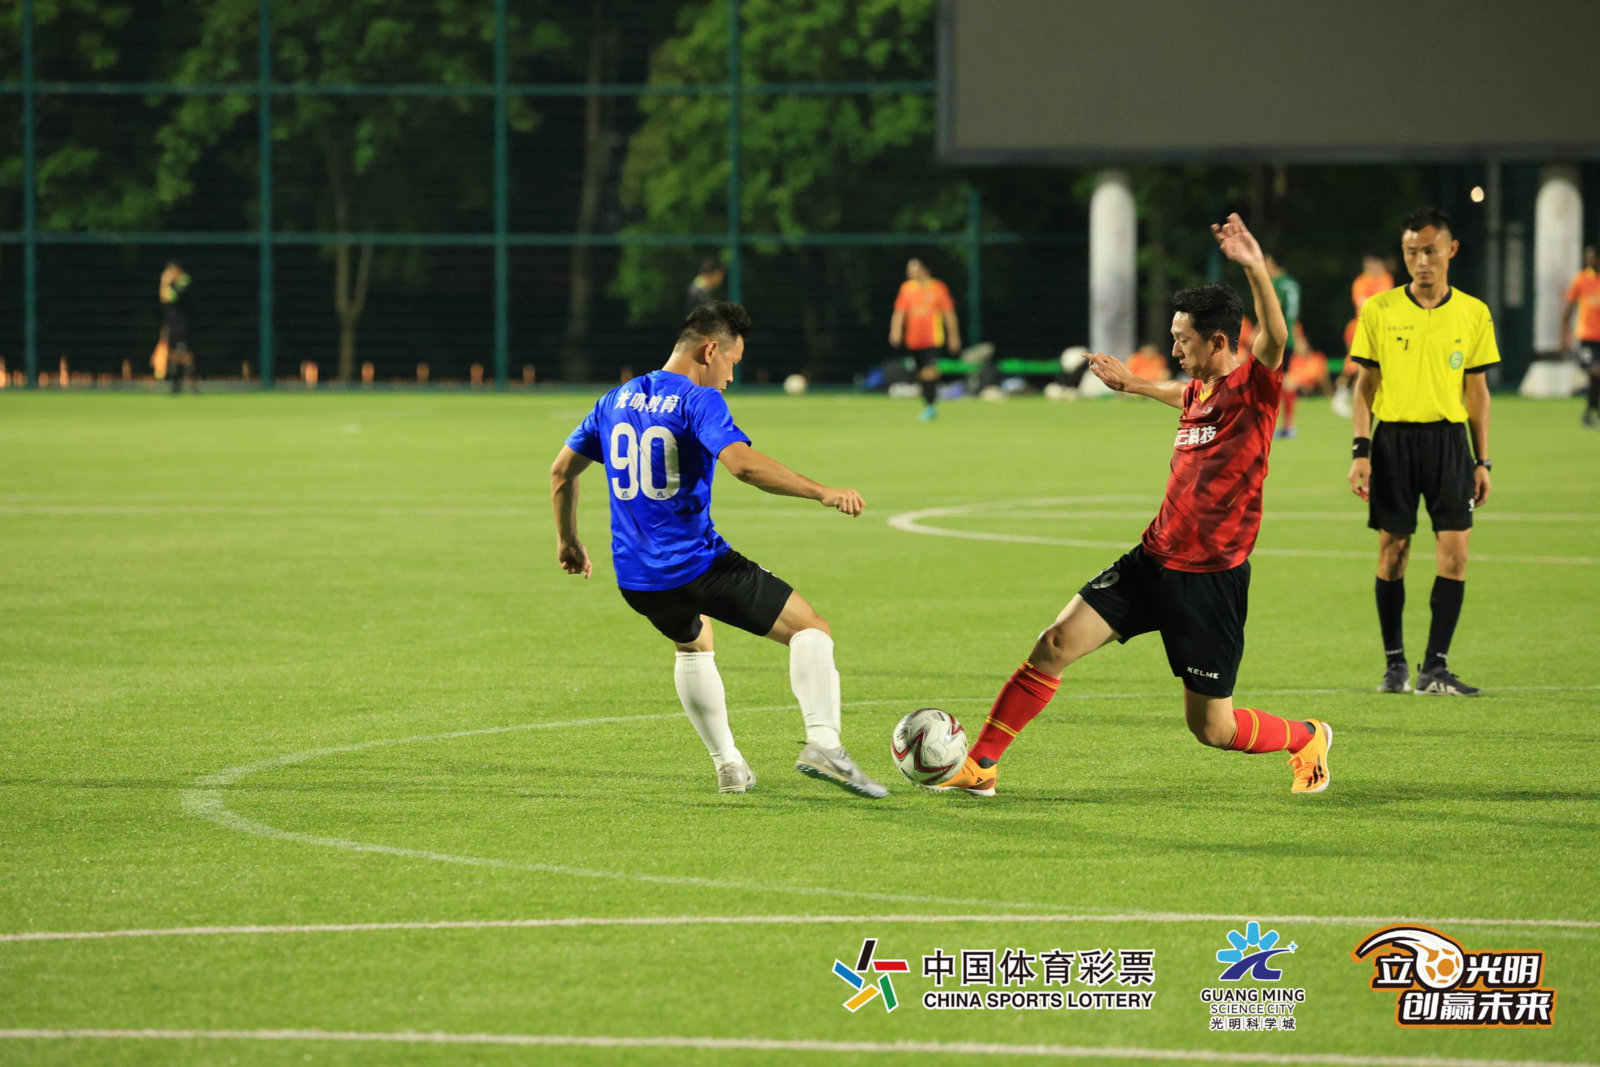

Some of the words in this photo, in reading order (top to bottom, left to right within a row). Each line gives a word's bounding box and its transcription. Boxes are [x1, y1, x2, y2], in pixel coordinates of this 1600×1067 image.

[614, 390, 681, 414] 光明教育
[610, 422, 680, 501] 90
[1088, 565, 1121, 590] 9
[1187, 666, 1220, 680] KELME
